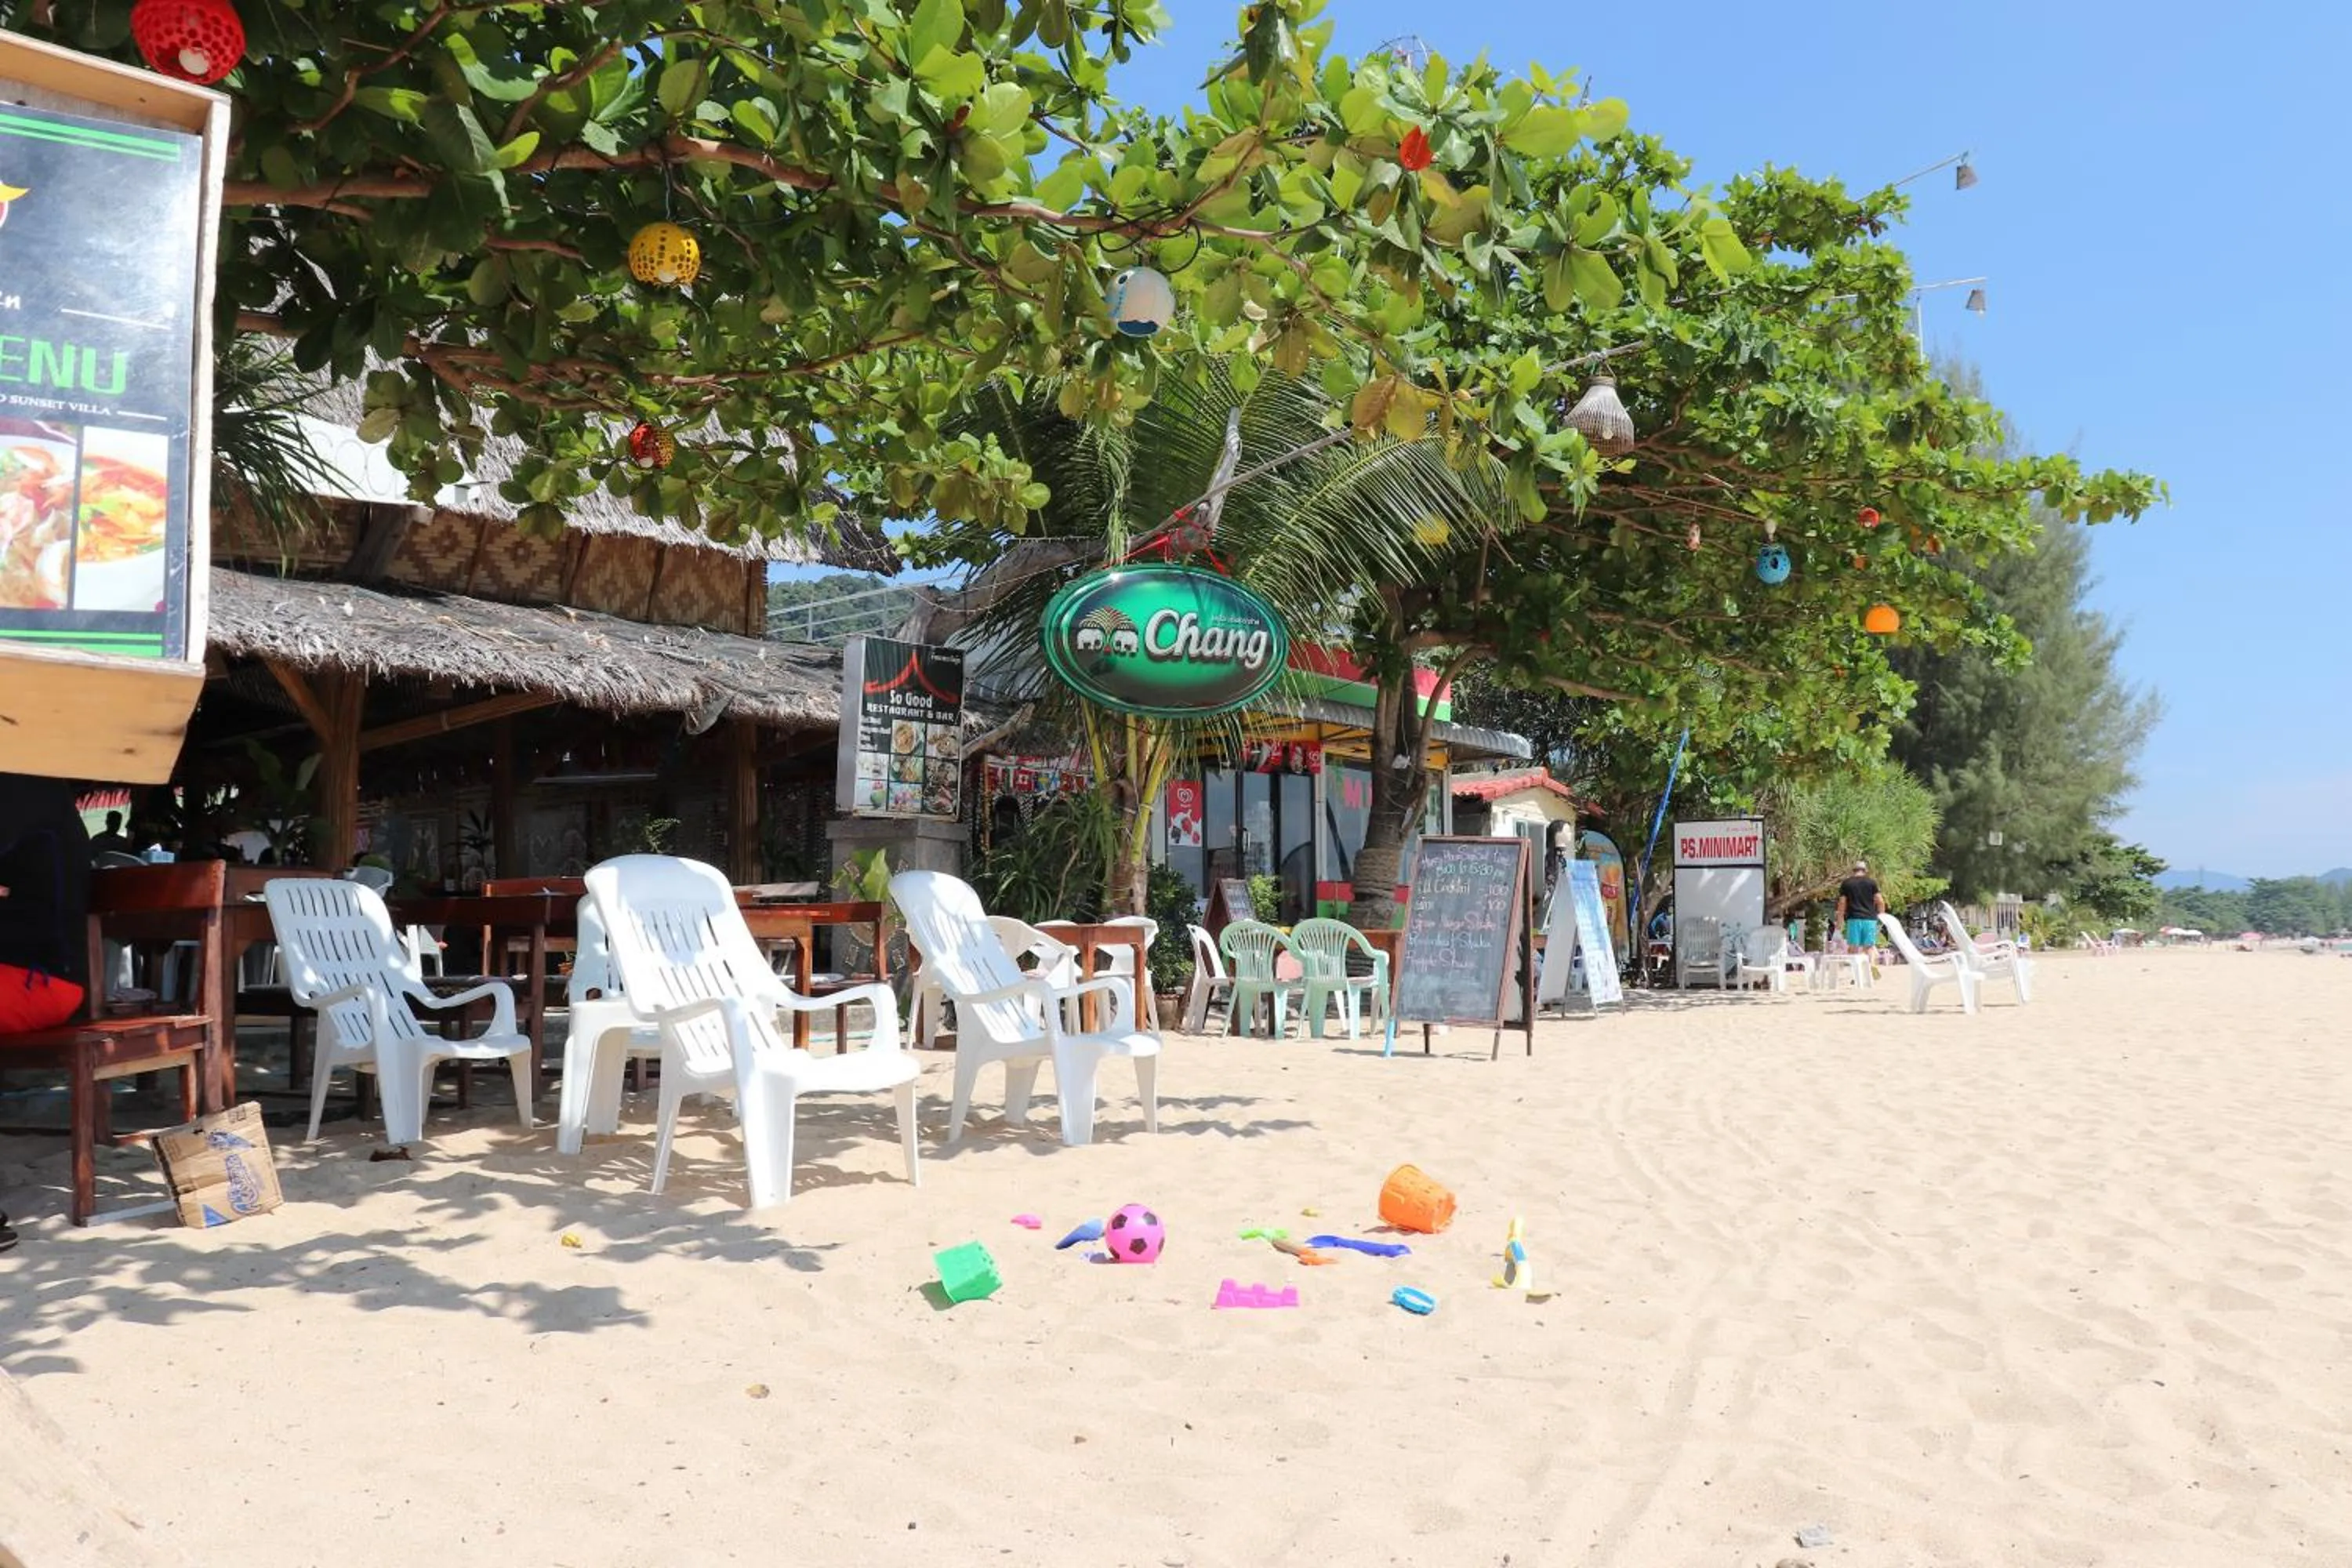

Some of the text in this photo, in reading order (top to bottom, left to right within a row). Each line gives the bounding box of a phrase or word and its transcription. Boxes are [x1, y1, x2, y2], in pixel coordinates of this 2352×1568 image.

[9, 394, 66, 410] SUNSET
[67, 401, 111, 416] VILLA
[1144, 608, 1269, 670] Chang
[890, 690, 933, 708] So Good
[866, 702, 925, 718] RESTAURANT
[935, 711, 954, 722] BAR
[1680, 835, 1759, 859] PS.MINIMART
